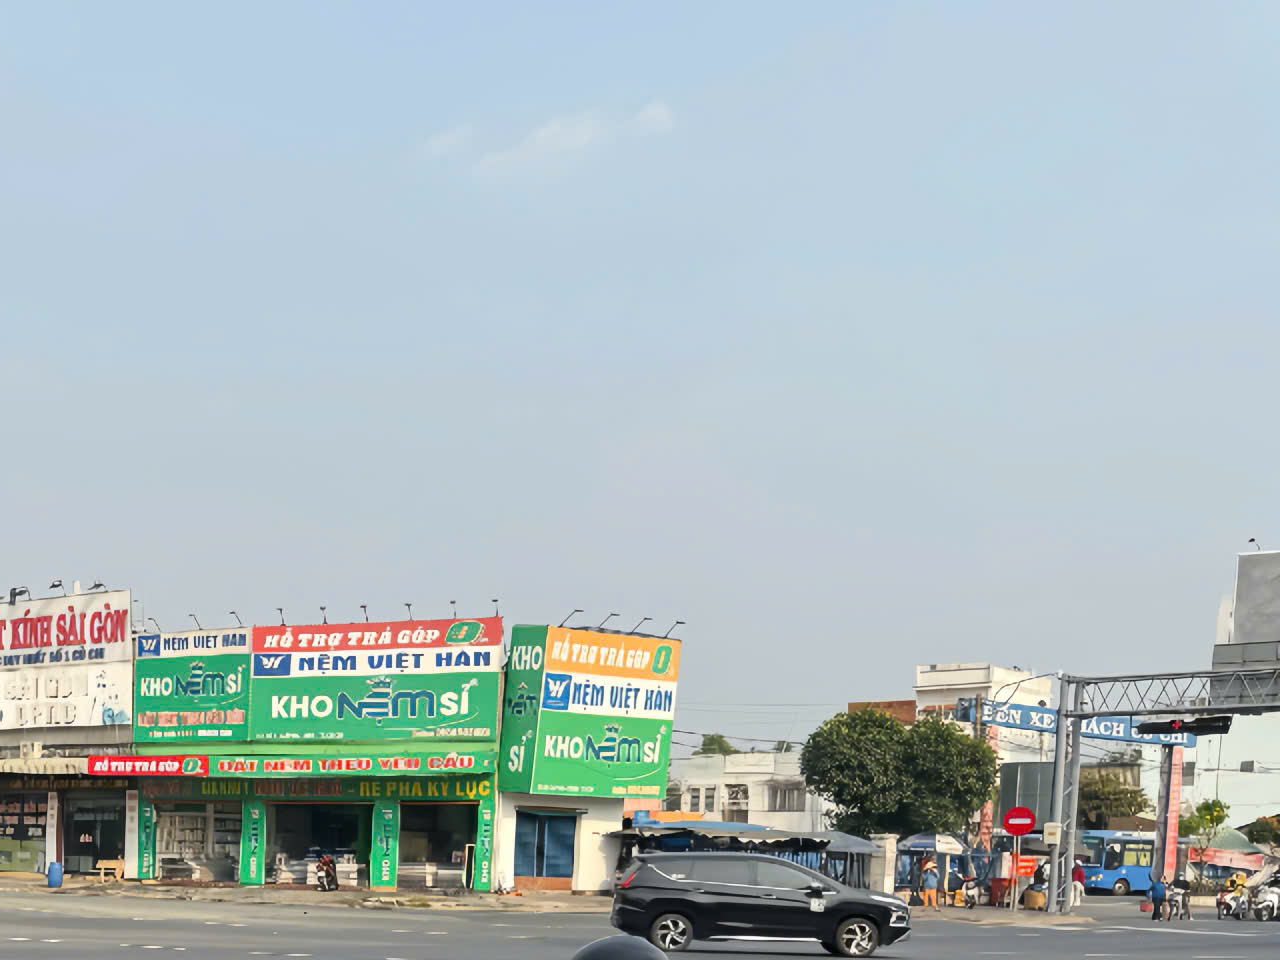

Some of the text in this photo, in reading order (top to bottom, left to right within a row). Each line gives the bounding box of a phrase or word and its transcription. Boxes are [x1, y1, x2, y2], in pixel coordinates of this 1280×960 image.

[10, 608, 53, 650] KÍNH
[56, 605, 86, 646] SÀI
[89, 602, 128, 644] GÒN
[396, 627, 441, 645] GÓP
[298, 650, 490, 675] NỆM VIỆT HÀN
[511, 645, 543, 670] KHO
[140, 677, 173, 697] KHO
[571, 679, 673, 715] NỆM VIỆT HÀN
[271, 695, 334, 719] KHO
[1030, 711, 1056, 729] XE
[544, 735, 584, 759] KHO
[455, 780, 490, 799] LỤC
